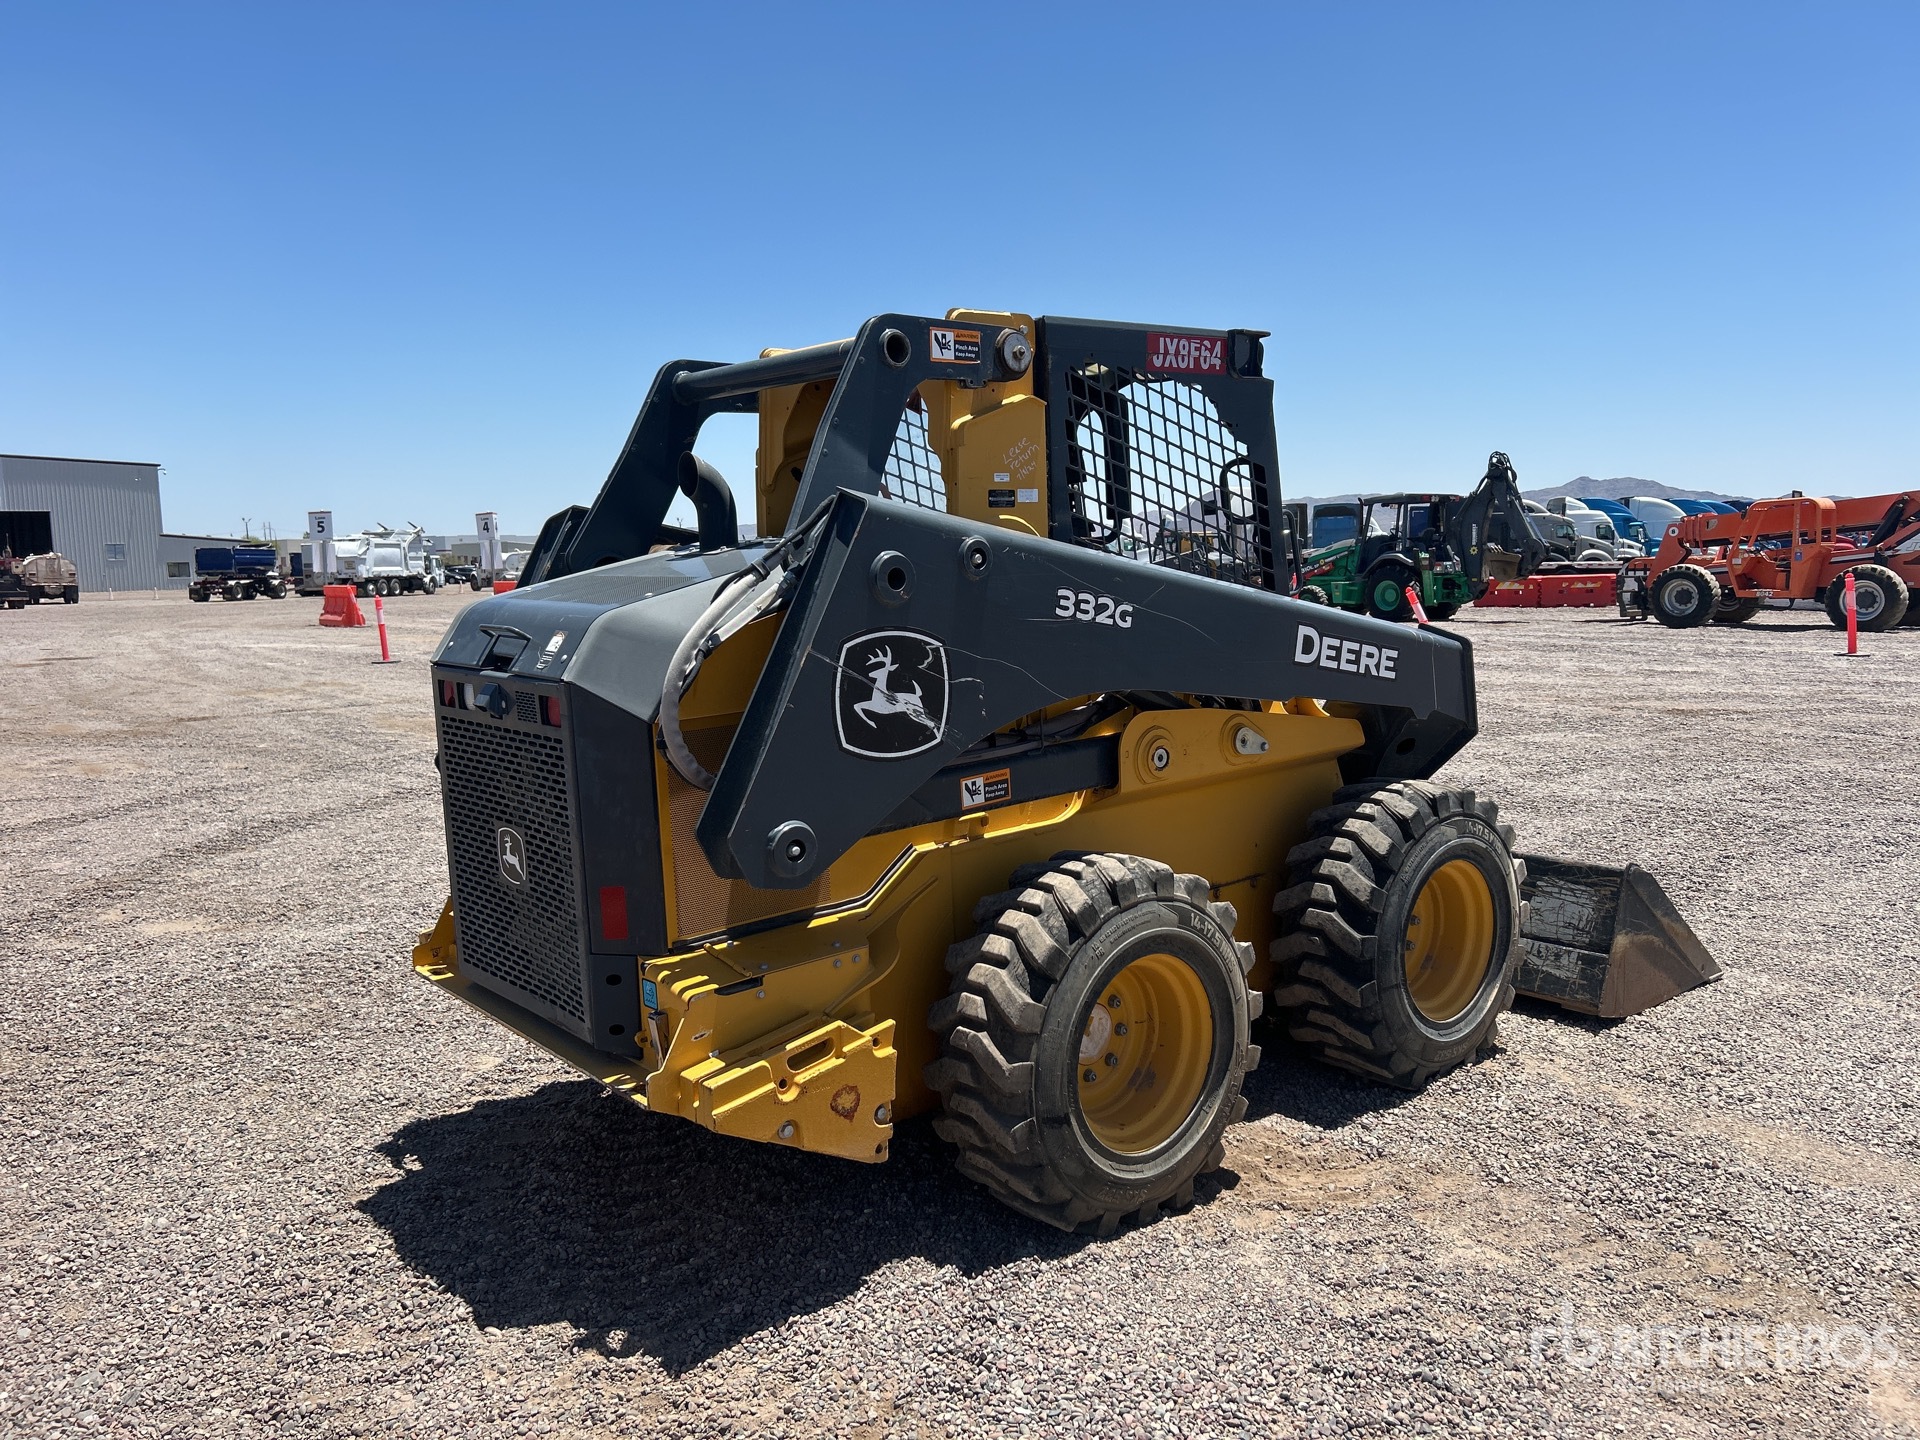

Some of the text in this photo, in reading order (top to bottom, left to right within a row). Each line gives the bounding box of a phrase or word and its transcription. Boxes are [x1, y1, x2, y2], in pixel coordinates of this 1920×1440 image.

[1153, 337, 1222, 370] JX8F64
[1009, 444, 1040, 470] return
[317, 520, 326, 534] 5
[482, 521, 490, 533] 4
[1055, 588, 1134, 628] 332G
[1294, 624, 1399, 679] DEERE
[1190, 912, 1221, 949] 14-17.5
